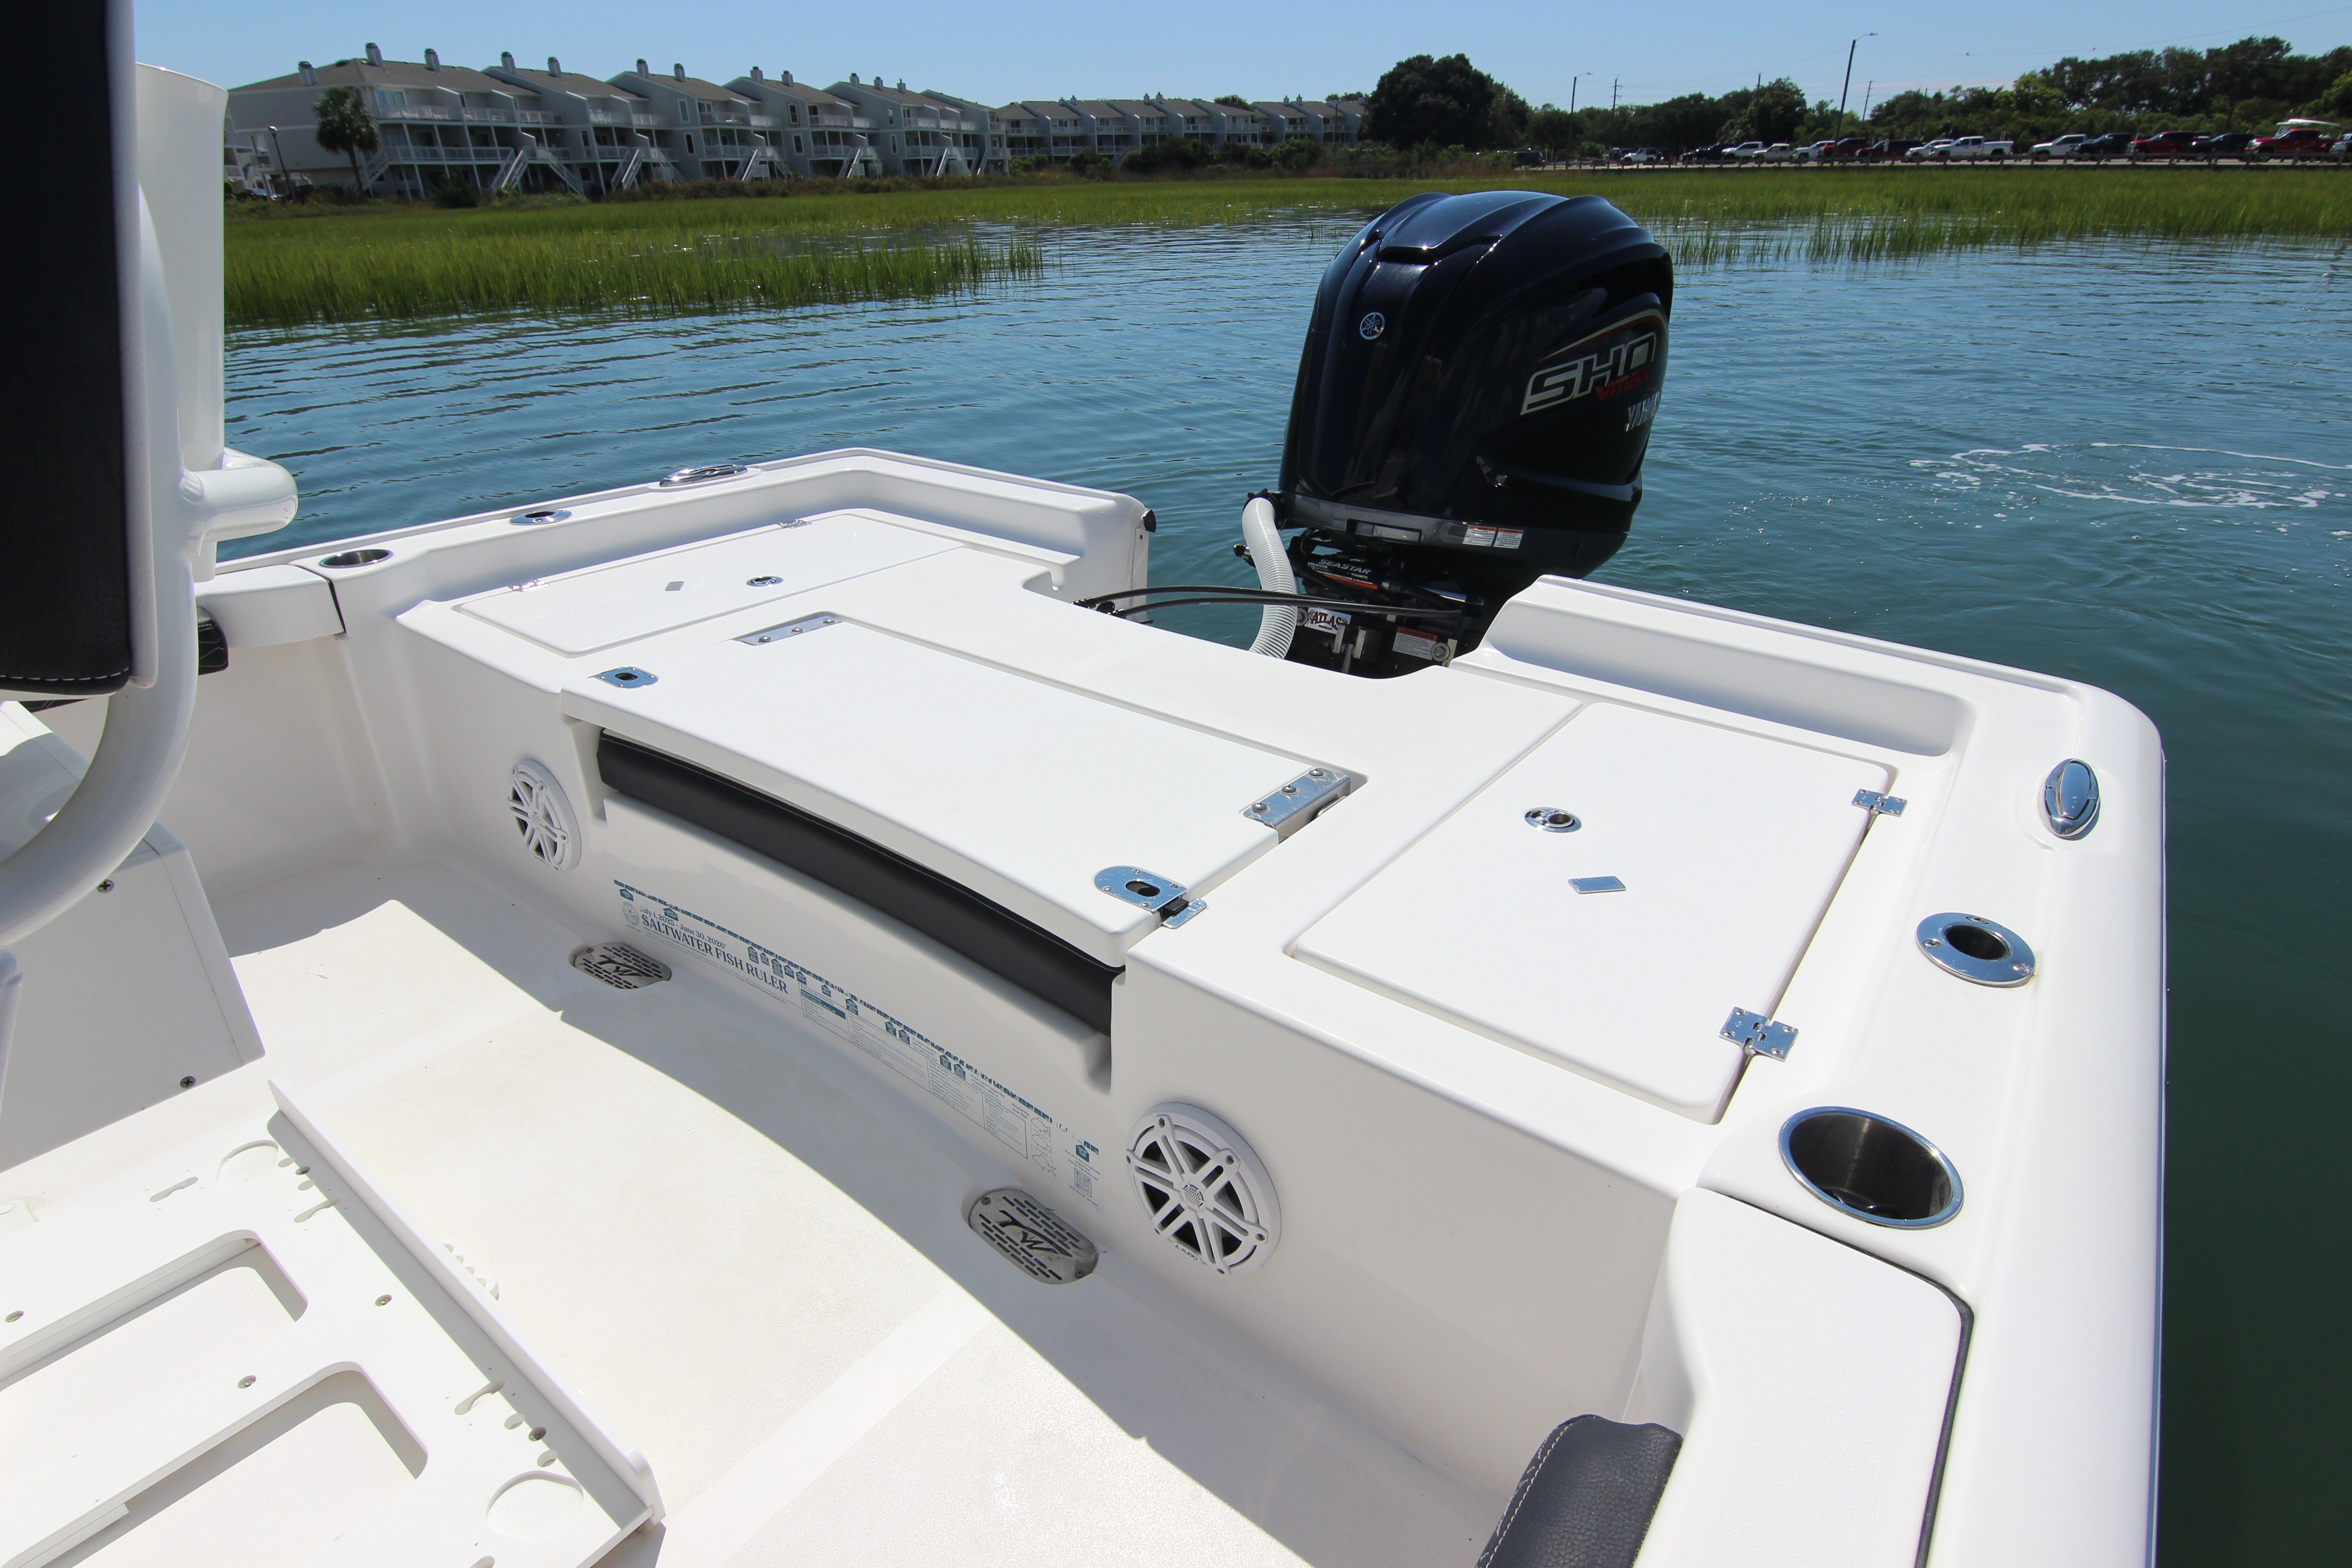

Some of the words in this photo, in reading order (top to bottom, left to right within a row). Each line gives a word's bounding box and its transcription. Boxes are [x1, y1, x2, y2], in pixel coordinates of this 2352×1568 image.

[1520, 332, 1656, 415] SHO
[1318, 559, 1371, 574] SEASTAR
[1310, 611, 1343, 630] ATLAS
[1405, 629, 1434, 640] WARNING
[640, 906, 652, 917] July
[658, 914, 675, 926] 2025
[680, 924, 695, 936] June
[696, 931, 706, 941] 30,
[642, 915, 714, 956] SALTWATER
[715, 947, 744, 971] FISH
[745, 962, 789, 995] RULER
[1181, 1248, 1198, 1260] AUDIO
